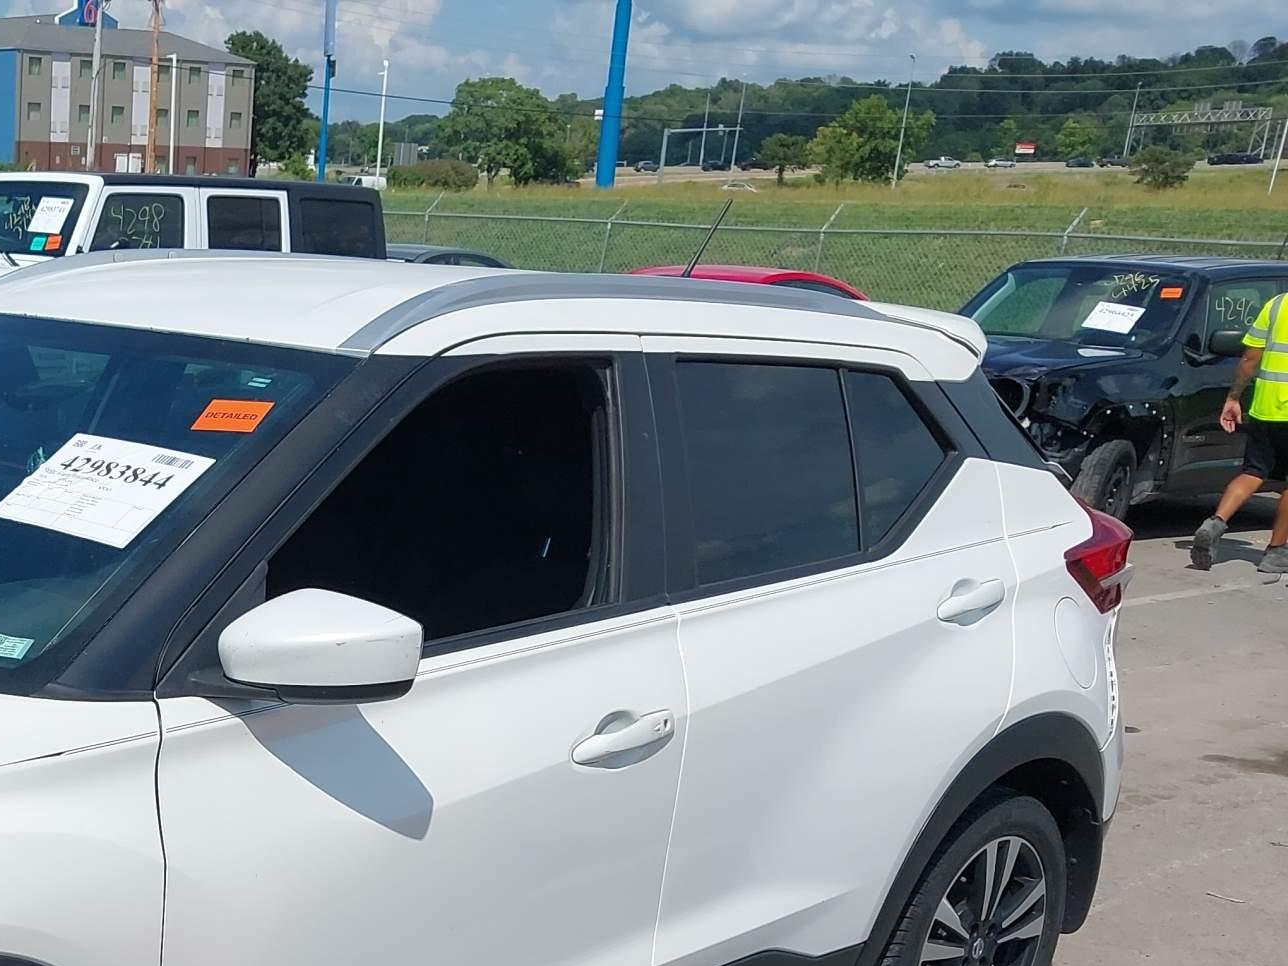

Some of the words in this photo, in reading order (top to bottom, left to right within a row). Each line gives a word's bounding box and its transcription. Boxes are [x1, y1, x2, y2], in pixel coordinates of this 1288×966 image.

[111, 203, 165, 235] 4298
[205, 411, 258, 420] DETAILED
[60, 455, 175, 490] 42983844
